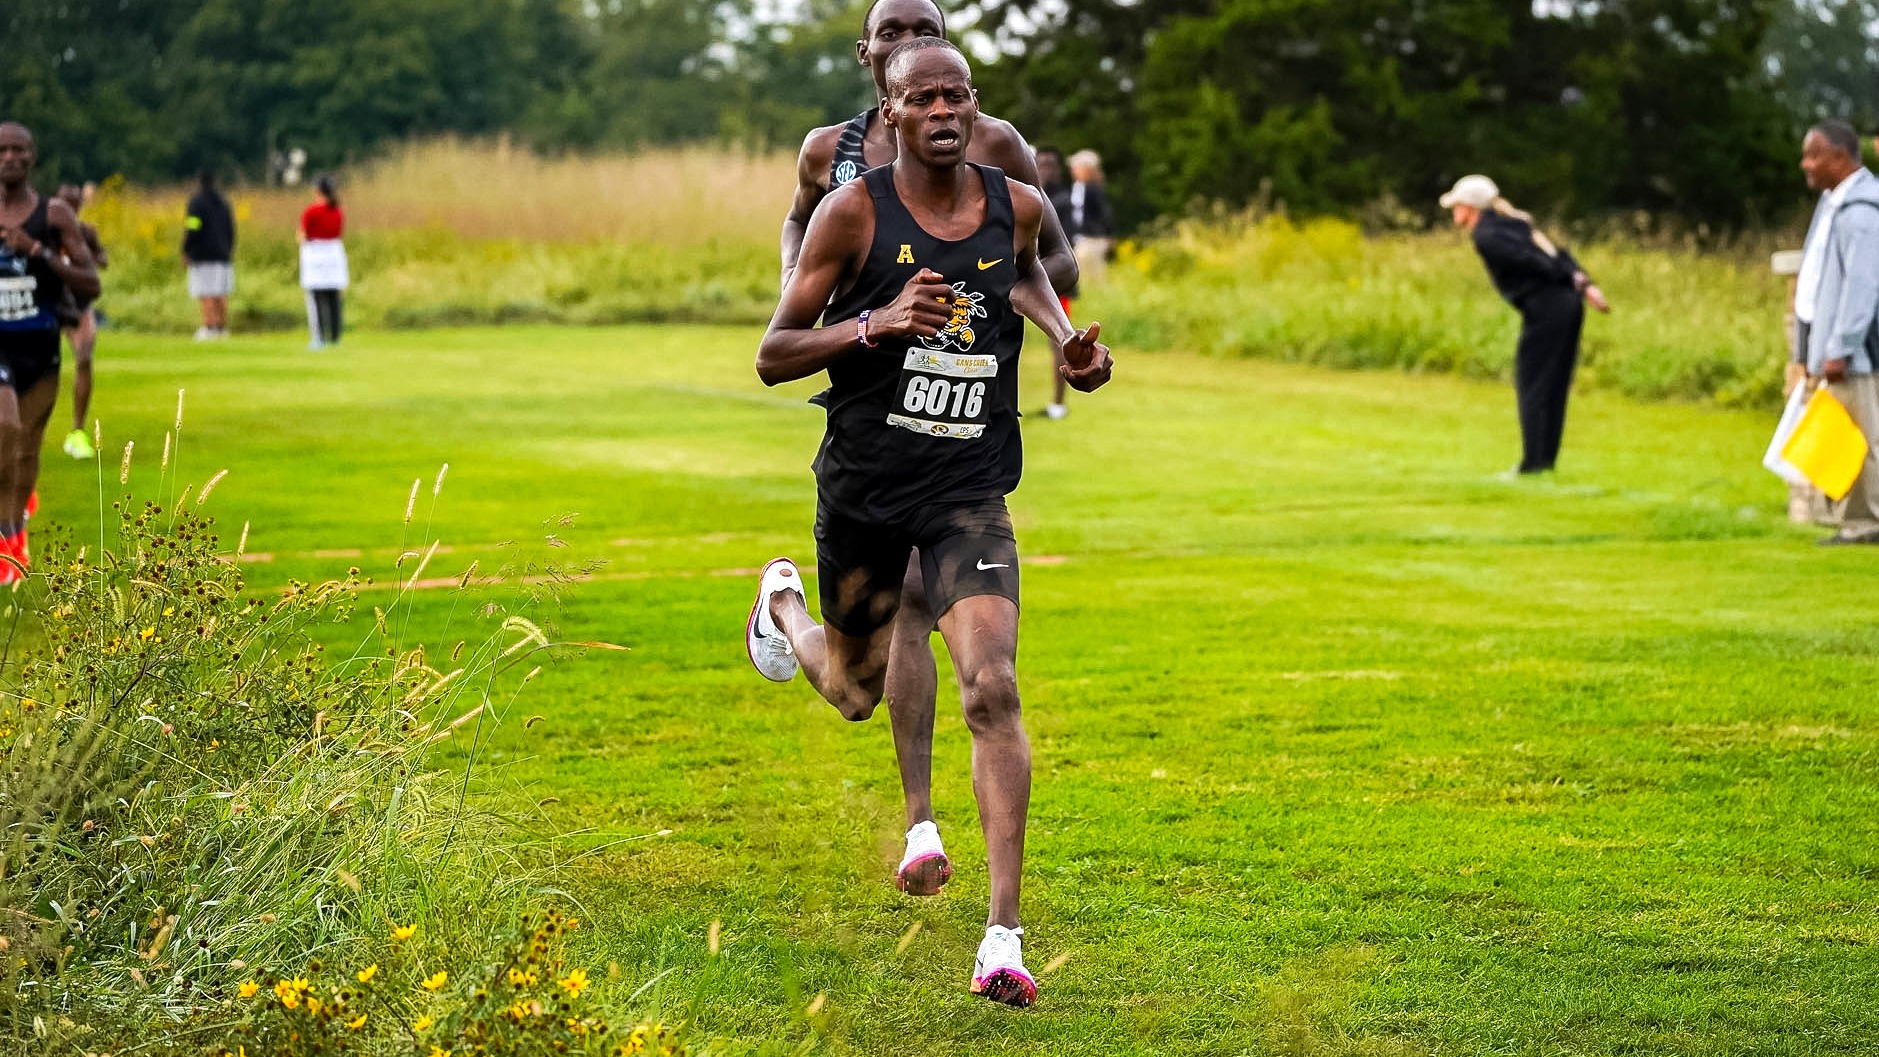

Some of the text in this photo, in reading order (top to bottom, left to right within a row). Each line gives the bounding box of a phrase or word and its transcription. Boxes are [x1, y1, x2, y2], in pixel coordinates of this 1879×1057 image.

[838, 162, 855, 182] SEC
[896, 244, 915, 264] A
[935, 331, 950, 344] WSU
[903, 375, 986, 418] 6016
